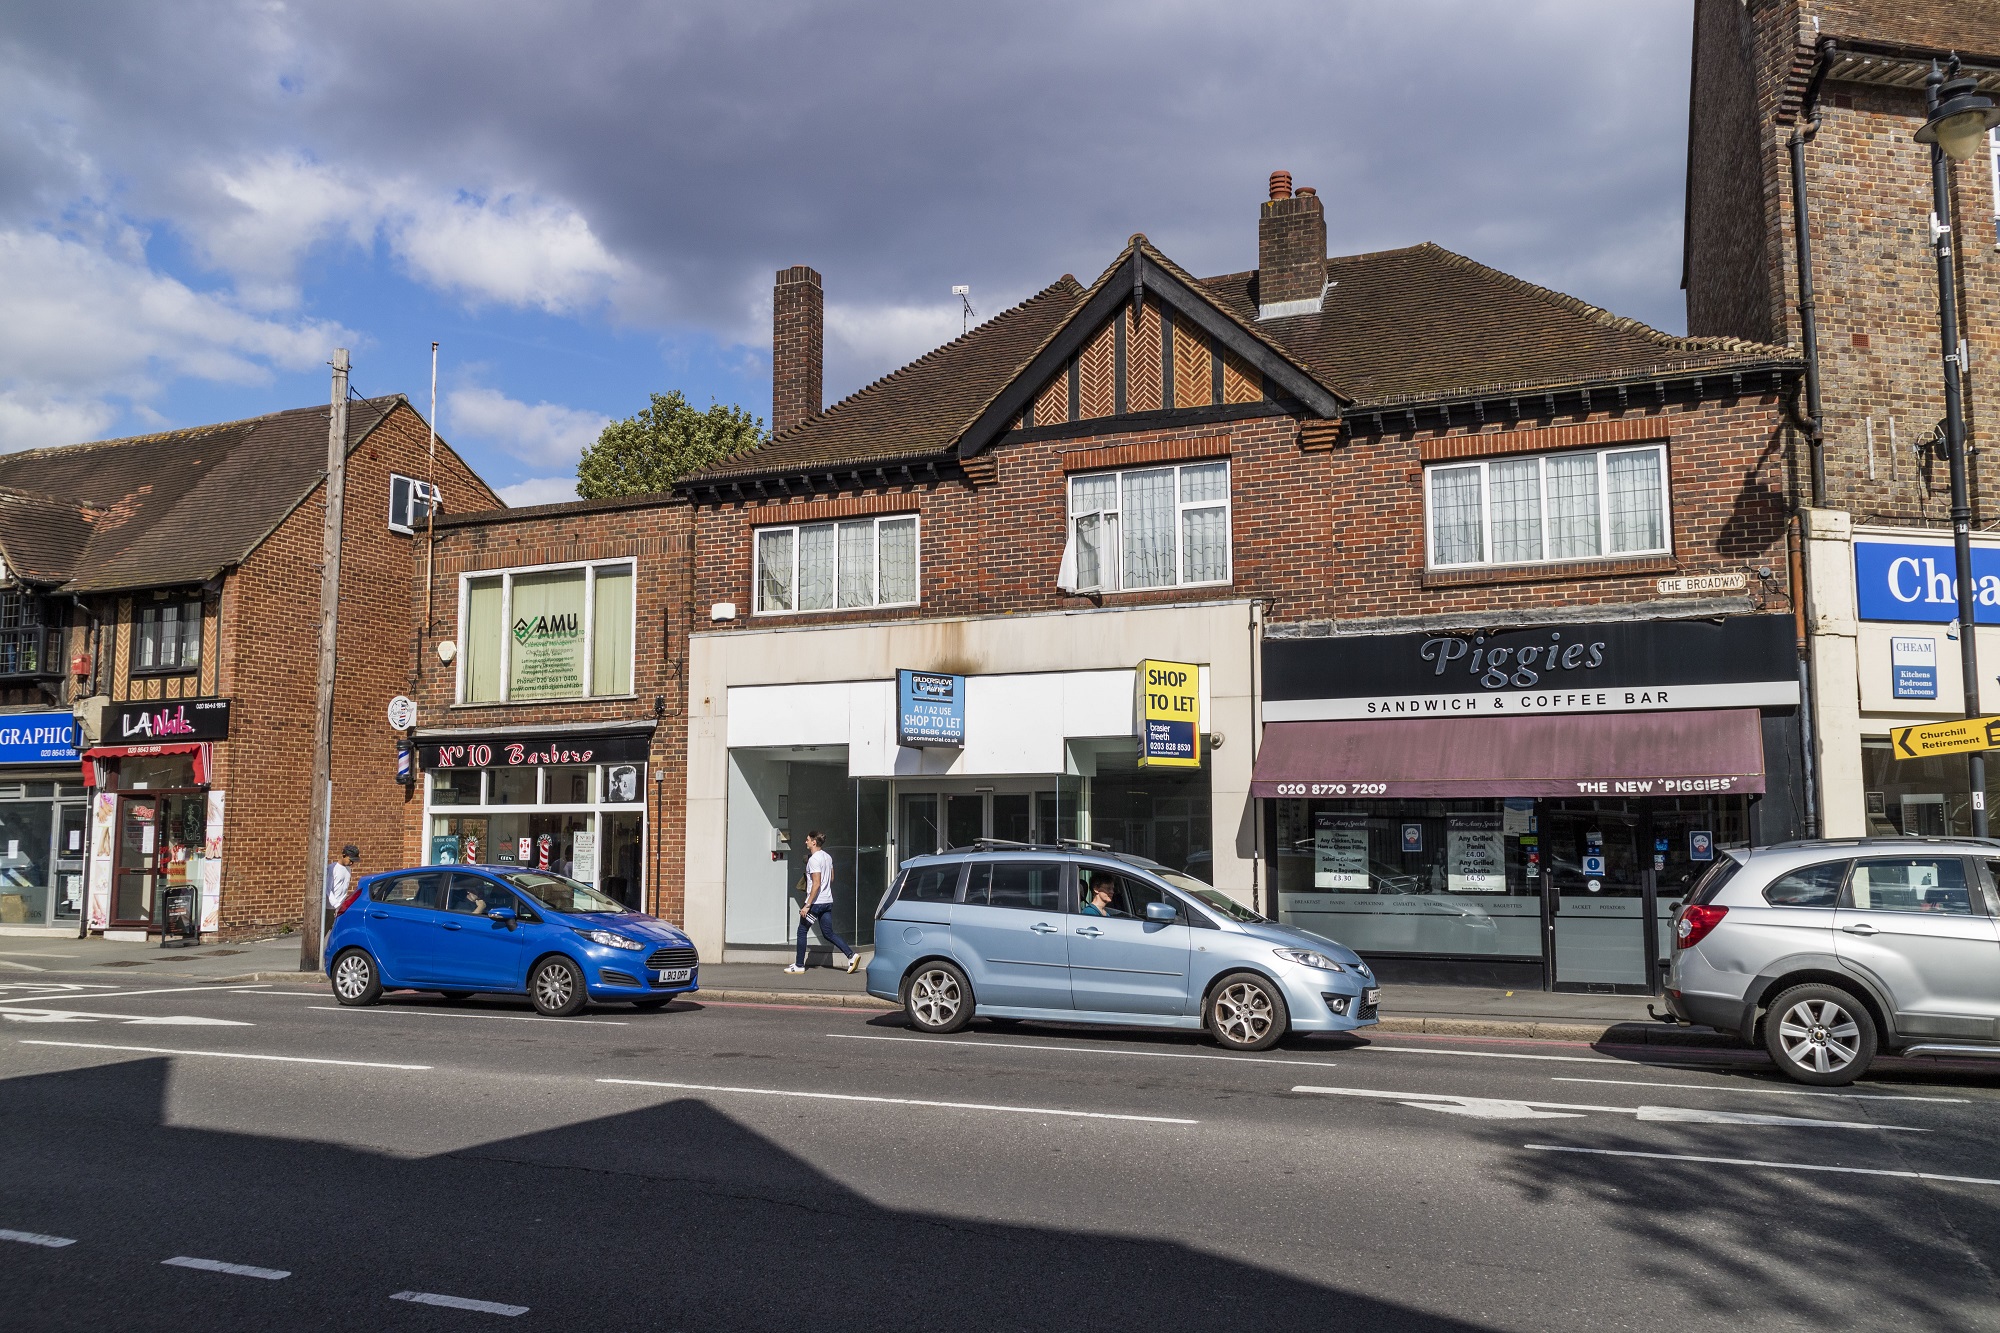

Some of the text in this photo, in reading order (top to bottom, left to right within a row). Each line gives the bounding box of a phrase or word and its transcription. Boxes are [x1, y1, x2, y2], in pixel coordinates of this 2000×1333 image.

[1661, 576, 1740, 591] THE BROADWAY
[536, 612, 577, 633] AMU
[1896, 642, 1932, 652] CHEAM
[1420, 632, 1605, 689] Piggies
[1148, 669, 1187, 687] SHOP
[1900, 670, 1930, 678] Kitchens
[1148, 694, 1195, 712] TO LET
[1367, 691, 1669, 713] SANDWICH & COFFEE BAR
[914, 705, 923, 714] A1
[928, 706, 938, 714] A2
[940, 707, 952, 716] USE
[122, 712, 153, 737] LA
[904, 714, 960, 728] SHOP TO LET
[1150, 722, 1170, 732] brasier
[0, 726, 72, 745] GRAPHIC
[1150, 732, 1170, 740] freeth
[1920, 728, 1967, 740] Churchill
[1150, 742, 1164, 750] 0203
[1178, 744, 1190, 752] 8530
[1922, 736, 1980, 749] Retirement
[40, 749, 51, 757] 020
[504, 744, 593, 765] Barbers
[1277, 784, 1387, 794] 020 8770 7209
[1576, 782, 1608, 792] THE
[1615, 781, 1653, 792] NEW
[1482, 820, 1501, 828] Special
[1352, 844, 1366, 852] Filling
